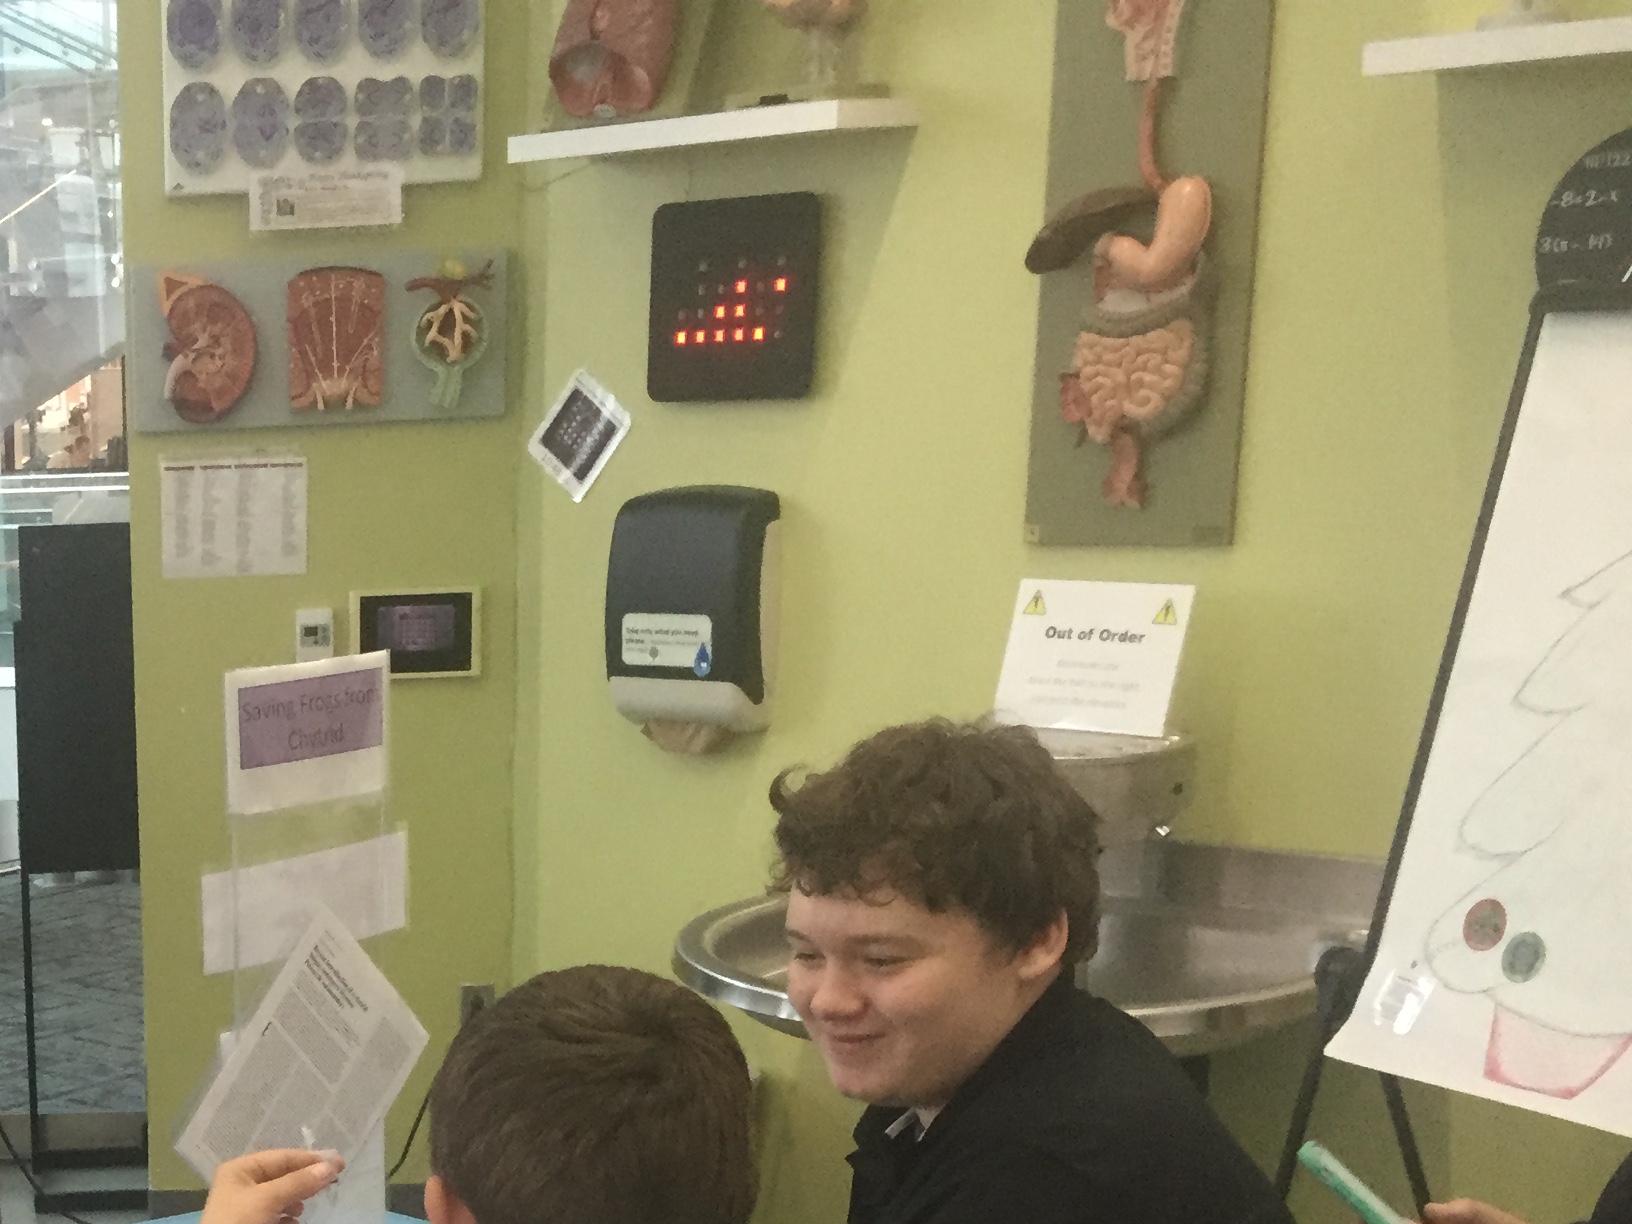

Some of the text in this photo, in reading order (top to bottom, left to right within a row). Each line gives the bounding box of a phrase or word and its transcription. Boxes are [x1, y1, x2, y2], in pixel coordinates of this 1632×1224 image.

[1044, 625, 1146, 644] Out of Order
[242, 686, 378, 722] Saving Frogs from
[287, 722, 345, 750] Chytrid
